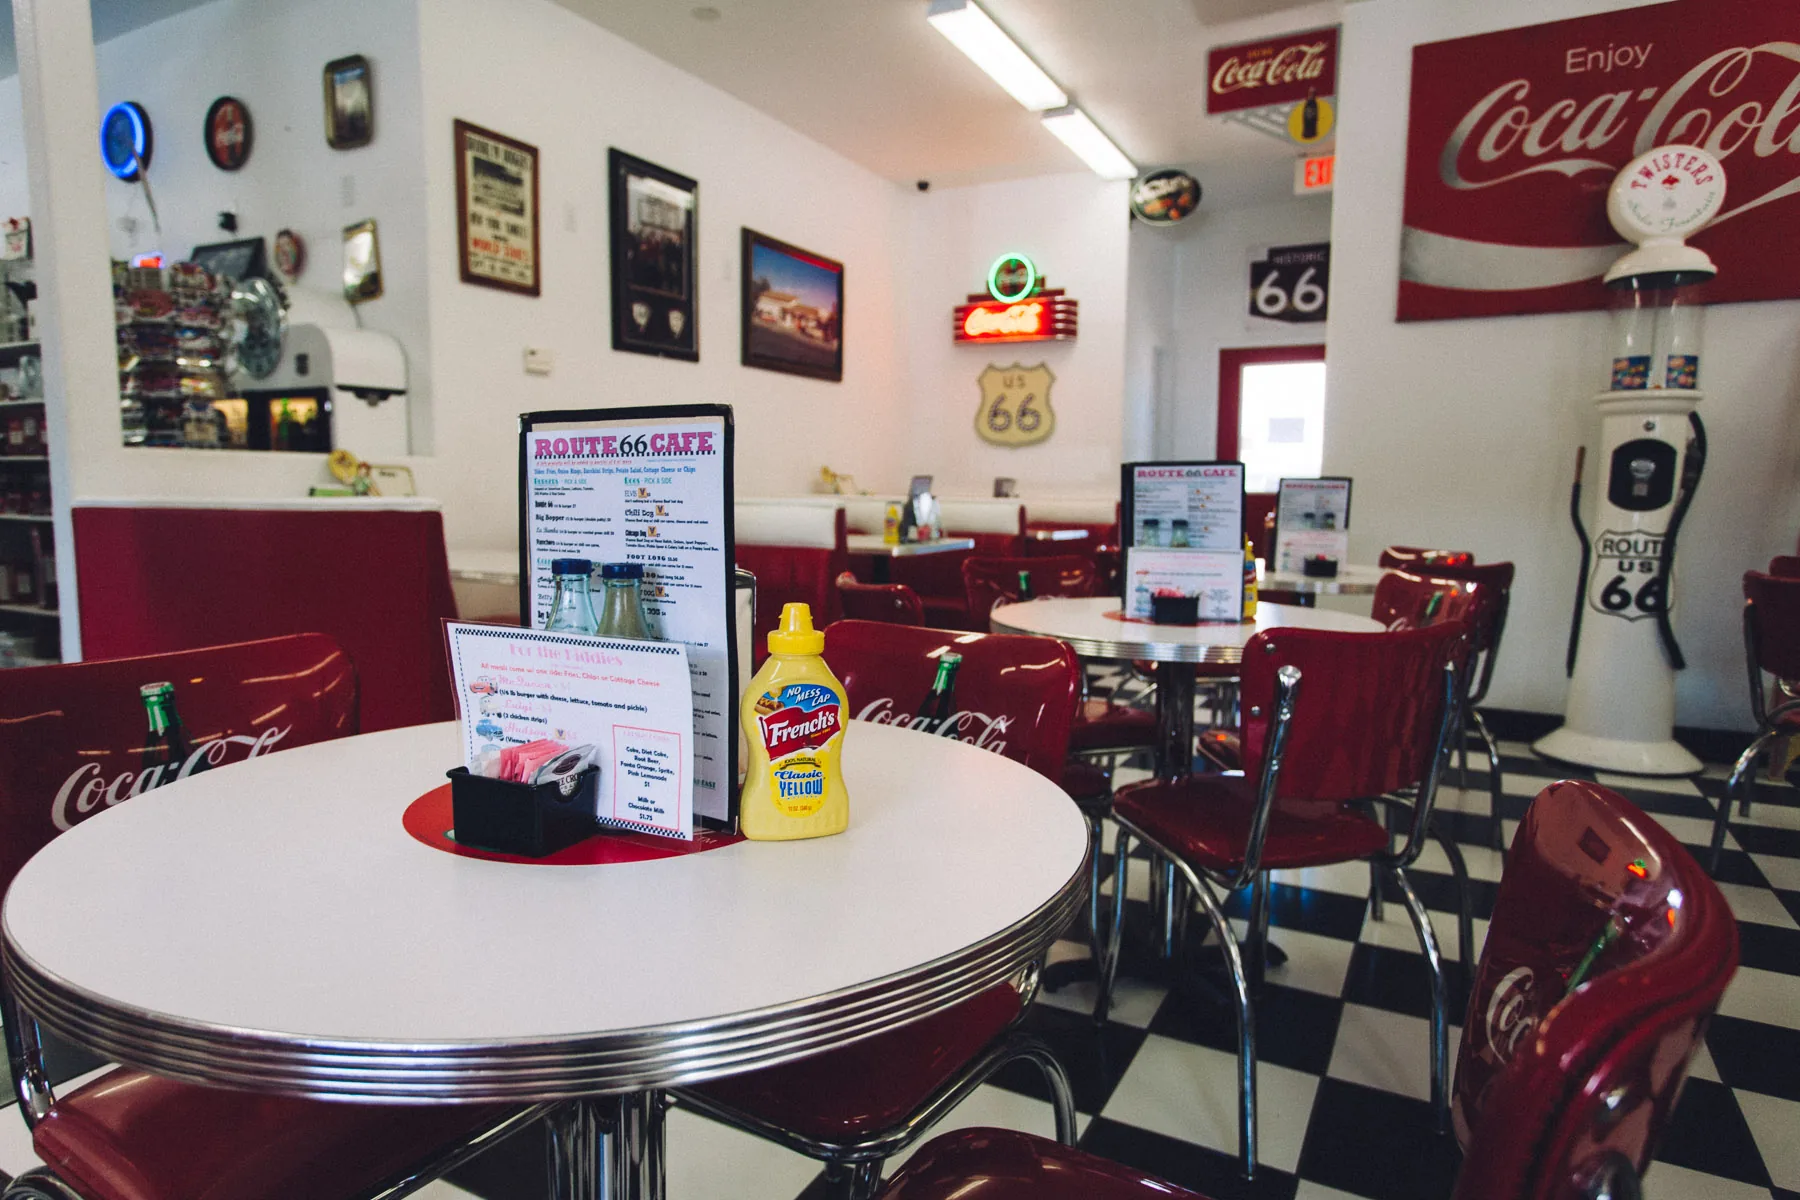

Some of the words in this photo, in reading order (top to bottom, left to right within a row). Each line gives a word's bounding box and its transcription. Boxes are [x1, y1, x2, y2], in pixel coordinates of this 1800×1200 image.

[1565, 43, 1654, 74] Enjoy
[1440, 41, 1800, 190] Coca-Col
[1630, 152, 1713, 190] TWISTERS
[1256, 266, 1325, 315] 66
[988, 393, 1041, 432] 66
[535, 436, 617, 456] ROUTE
[619, 434, 648, 454] 66
[650, 431, 713, 452] CAFE
[1602, 537, 1666, 555] ROUT
[1618, 559, 1654, 573] US
[1600, 575, 1664, 612] 66
[610, 676, 635, 685] Cottage
[637, 678, 660, 686] Cheese
[517, 690, 535, 699] burger
[550, 693, 569, 703] cheese,
[570, 697, 590, 706] lettuce,
[592, 700, 613, 708] tomato
[614, 702, 626, 710] and
[787, 686, 801, 698] NO
[795, 688, 821, 704] MESS
[812, 693, 831, 707] CAP
[510, 712, 530, 721] chicken
[531, 715, 548, 725] strips)
[768, 711, 836, 748] French's
[626, 746, 640, 755] Coke,
[641, 748, 652, 756] Diet
[654, 750, 669, 759] Coke,
[620, 760, 636, 768] Fanta
[637, 763, 657, 773] Orange,
[658, 766, 675, 776] Sprite,
[647, 757, 661, 765] Beer,
[640, 772, 667, 782] Lemonade
[774, 770, 823, 780] Classic
[779, 778, 822, 798] YELLOW
[628, 802, 653, 812] Chocolate
[639, 813, 653, 821] $1.75
